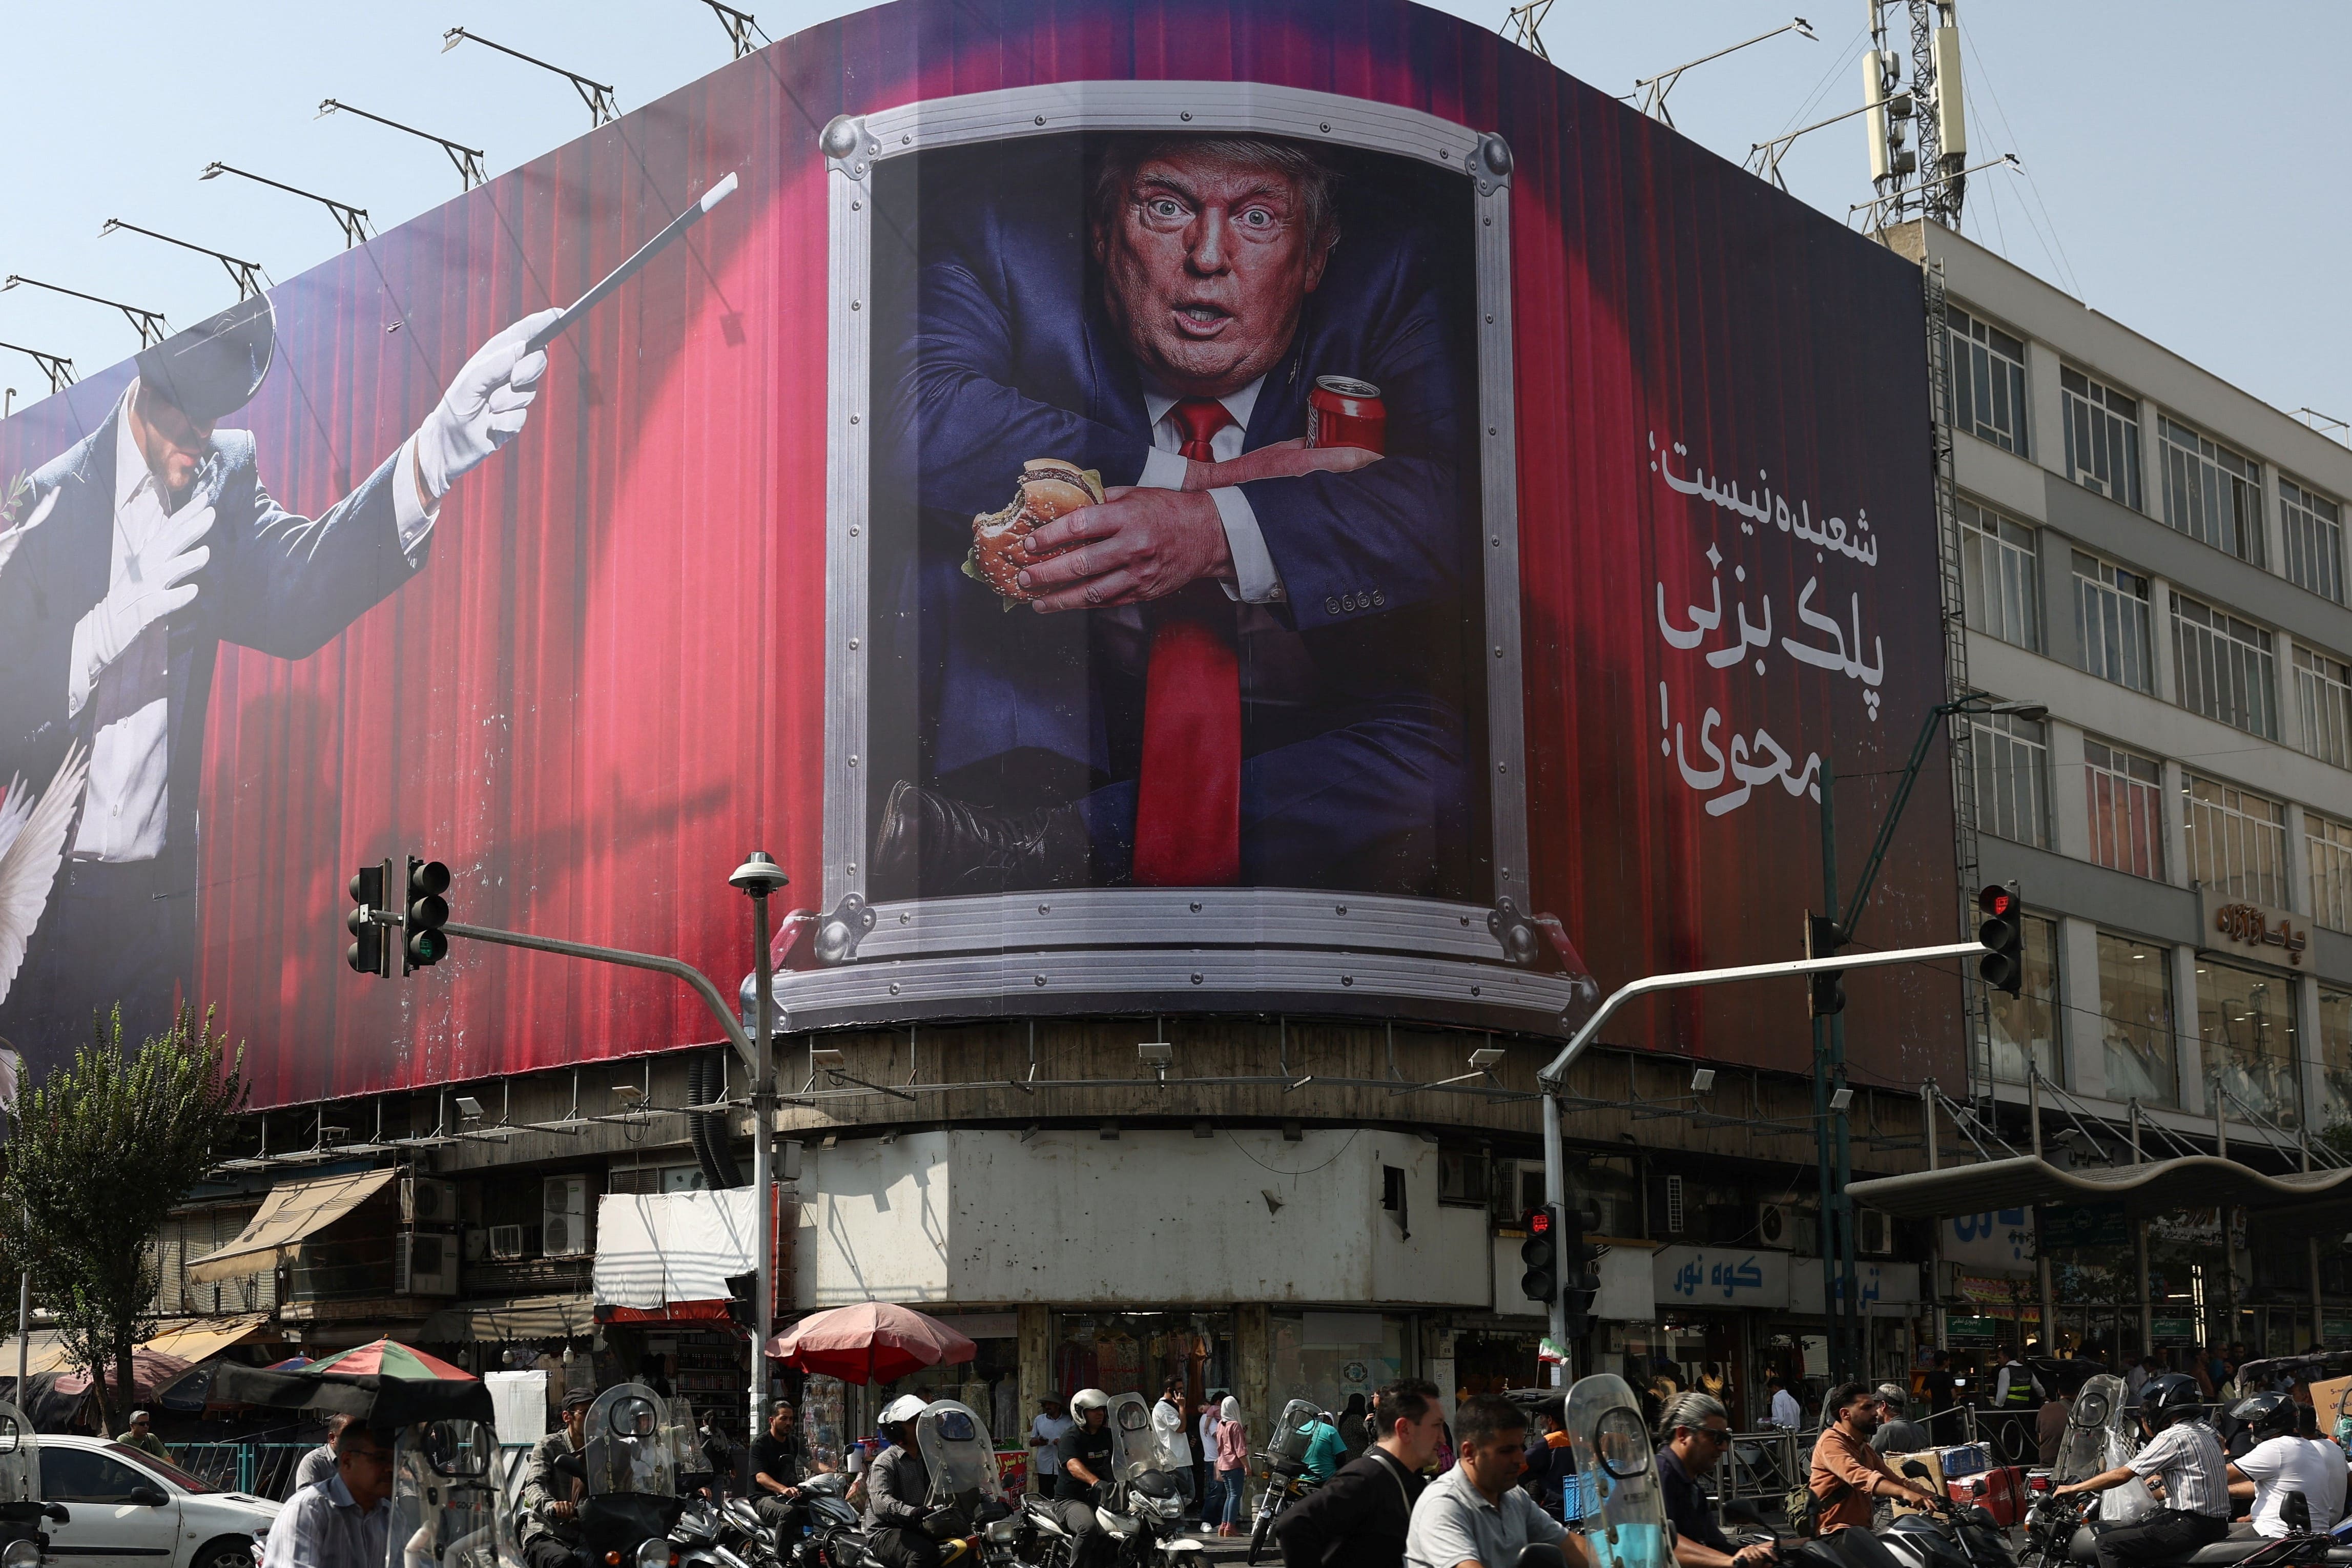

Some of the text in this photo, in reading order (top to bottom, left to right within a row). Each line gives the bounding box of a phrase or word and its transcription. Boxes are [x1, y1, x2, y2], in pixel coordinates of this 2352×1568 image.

[1775, 493, 1879, 567] شعبده
[1657, 541, 1884, 722] پلک بزنی
[1673, 1253, 1762, 1298] کوه نور
